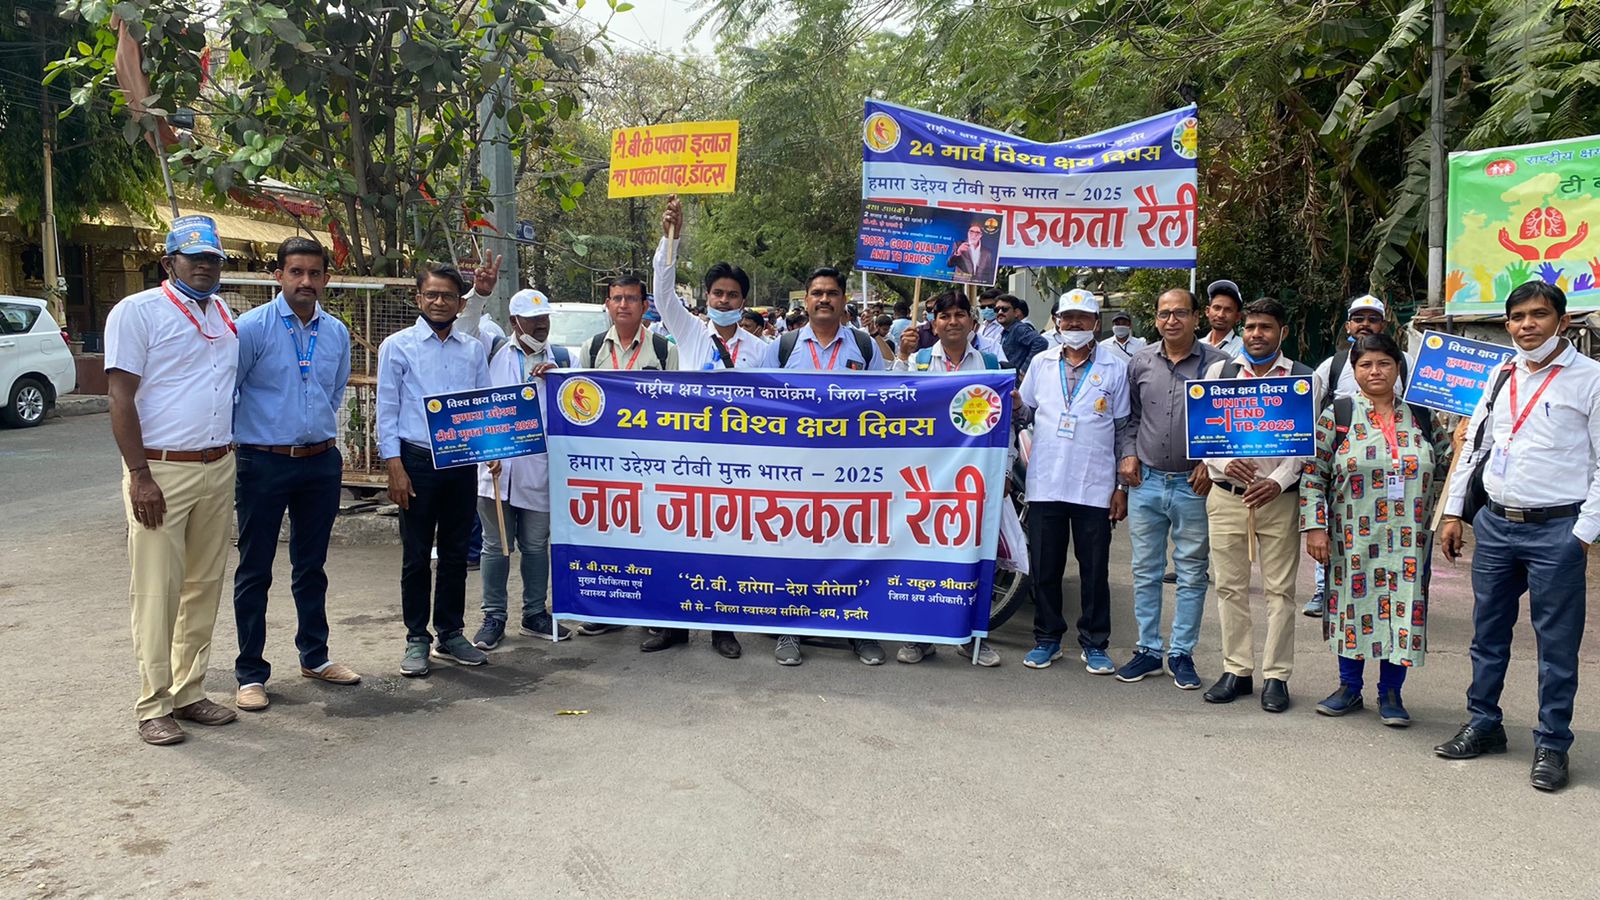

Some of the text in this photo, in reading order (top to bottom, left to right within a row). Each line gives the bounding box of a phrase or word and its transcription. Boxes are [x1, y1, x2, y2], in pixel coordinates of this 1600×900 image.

[655, 134, 689, 154] पक्का
[690, 133, 732, 157] इलाज
[910, 140, 1163, 171] 24 मार्च विश्व क्षय दिवस
[1526, 149, 1574, 165] राष्ट्रीय
[629, 166, 661, 186] पक्का
[1560, 174, 1586, 193] टी
[868, 177, 905, 191] हमारा
[910, 174, 947, 195] उद्देश्य
[952, 177, 984, 196] टीबी
[989, 185, 1016, 202] मुक्त
[1022, 187, 1059, 200] भारत
[1083, 187, 1122, 201] 2025
[1133, 183, 1197, 247] रैली
[870, 248, 890, 260] ANTI
[891, 250, 903, 261] TB
[890, 239, 913, 250] GOOD
[914, 242, 950, 255] QUALITY
[1448, 341, 1476, 355] विश्व
[1477, 349, 1499, 360] क्षय
[635, 378, 673, 399] राष्ट्रीय
[679, 383, 703, 398] क्षय
[760, 383, 823, 403] कार्यक्रम,
[1210, 383, 1288, 396] विश्व क्षय दिवस
[446, 392, 516, 409] विश्व क्षय दिवस
[1212, 396, 1282, 408] UNITE TO
[451, 410, 484, 425] हमारा
[1234, 408, 1265, 418] END
[617, 406, 936, 439] 24 मार्च विश्व क्षय दिवस
[1234, 420, 1294, 432] TB-2025
[568, 454, 614, 472] हमारा
[620, 451, 666, 477] उद्देश्य
[672, 454, 711, 476] टीबी
[718, 462, 751, 484] मुक्त
[758, 464, 803, 482] भारत
[834, 466, 883, 483] 2025
[567, 465, 986, 547] जन जागरुकता रैली
[569, 559, 583, 570] डॉ.
[578, 575, 643, 589] मुख्य चिकित्सा एवं
[887, 575, 903, 586] डॉ.
[906, 578, 936, 591] राहुल
[580, 588, 641, 600] स्वास्थ्य अधिकारी
[888, 590, 909, 601] जिला
[911, 593, 925, 603] क्षय
[680, 599, 692, 611] सौ
[714, 600, 740, 614] जिला
[742, 605, 777, 616] स्वास्थ्य
[843, 606, 869, 621] इन्दौर
